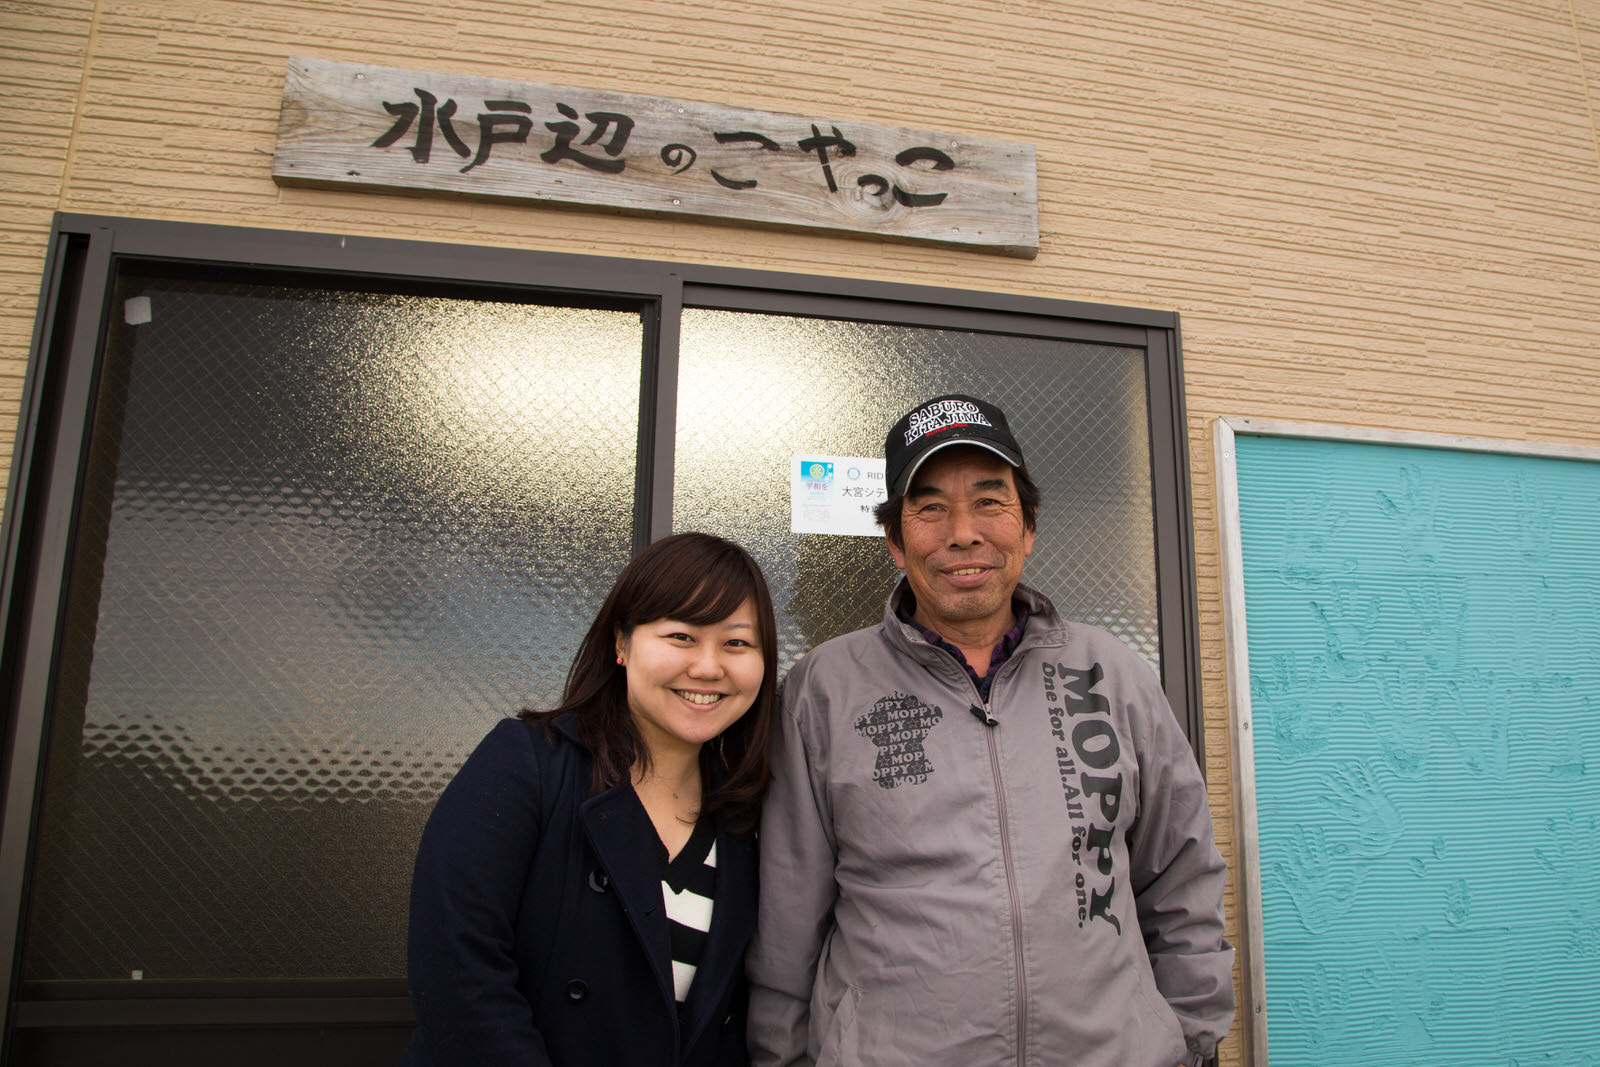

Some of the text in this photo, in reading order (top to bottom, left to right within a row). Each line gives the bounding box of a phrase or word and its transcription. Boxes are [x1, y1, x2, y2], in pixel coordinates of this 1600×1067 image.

[370, 87, 955, 208] 水戸辺のこやっこ
[904, 411, 992, 446] KITAJIMA
[909, 399, 980, 428] SABURO
[867, 472, 884, 480] RID
[1041, 660, 1058, 703] One
[855, 716, 942, 737] MOPPY MO
[887, 703, 936, 721] MOPPY
[1048, 705, 1066, 742] for
[879, 742, 908, 757] PPY
[872, 764, 910, 780] OPPY
[1057, 662, 1122, 937] MOPPY
[1071, 824, 1087, 867] for
[1075, 872, 1089, 930] one.
